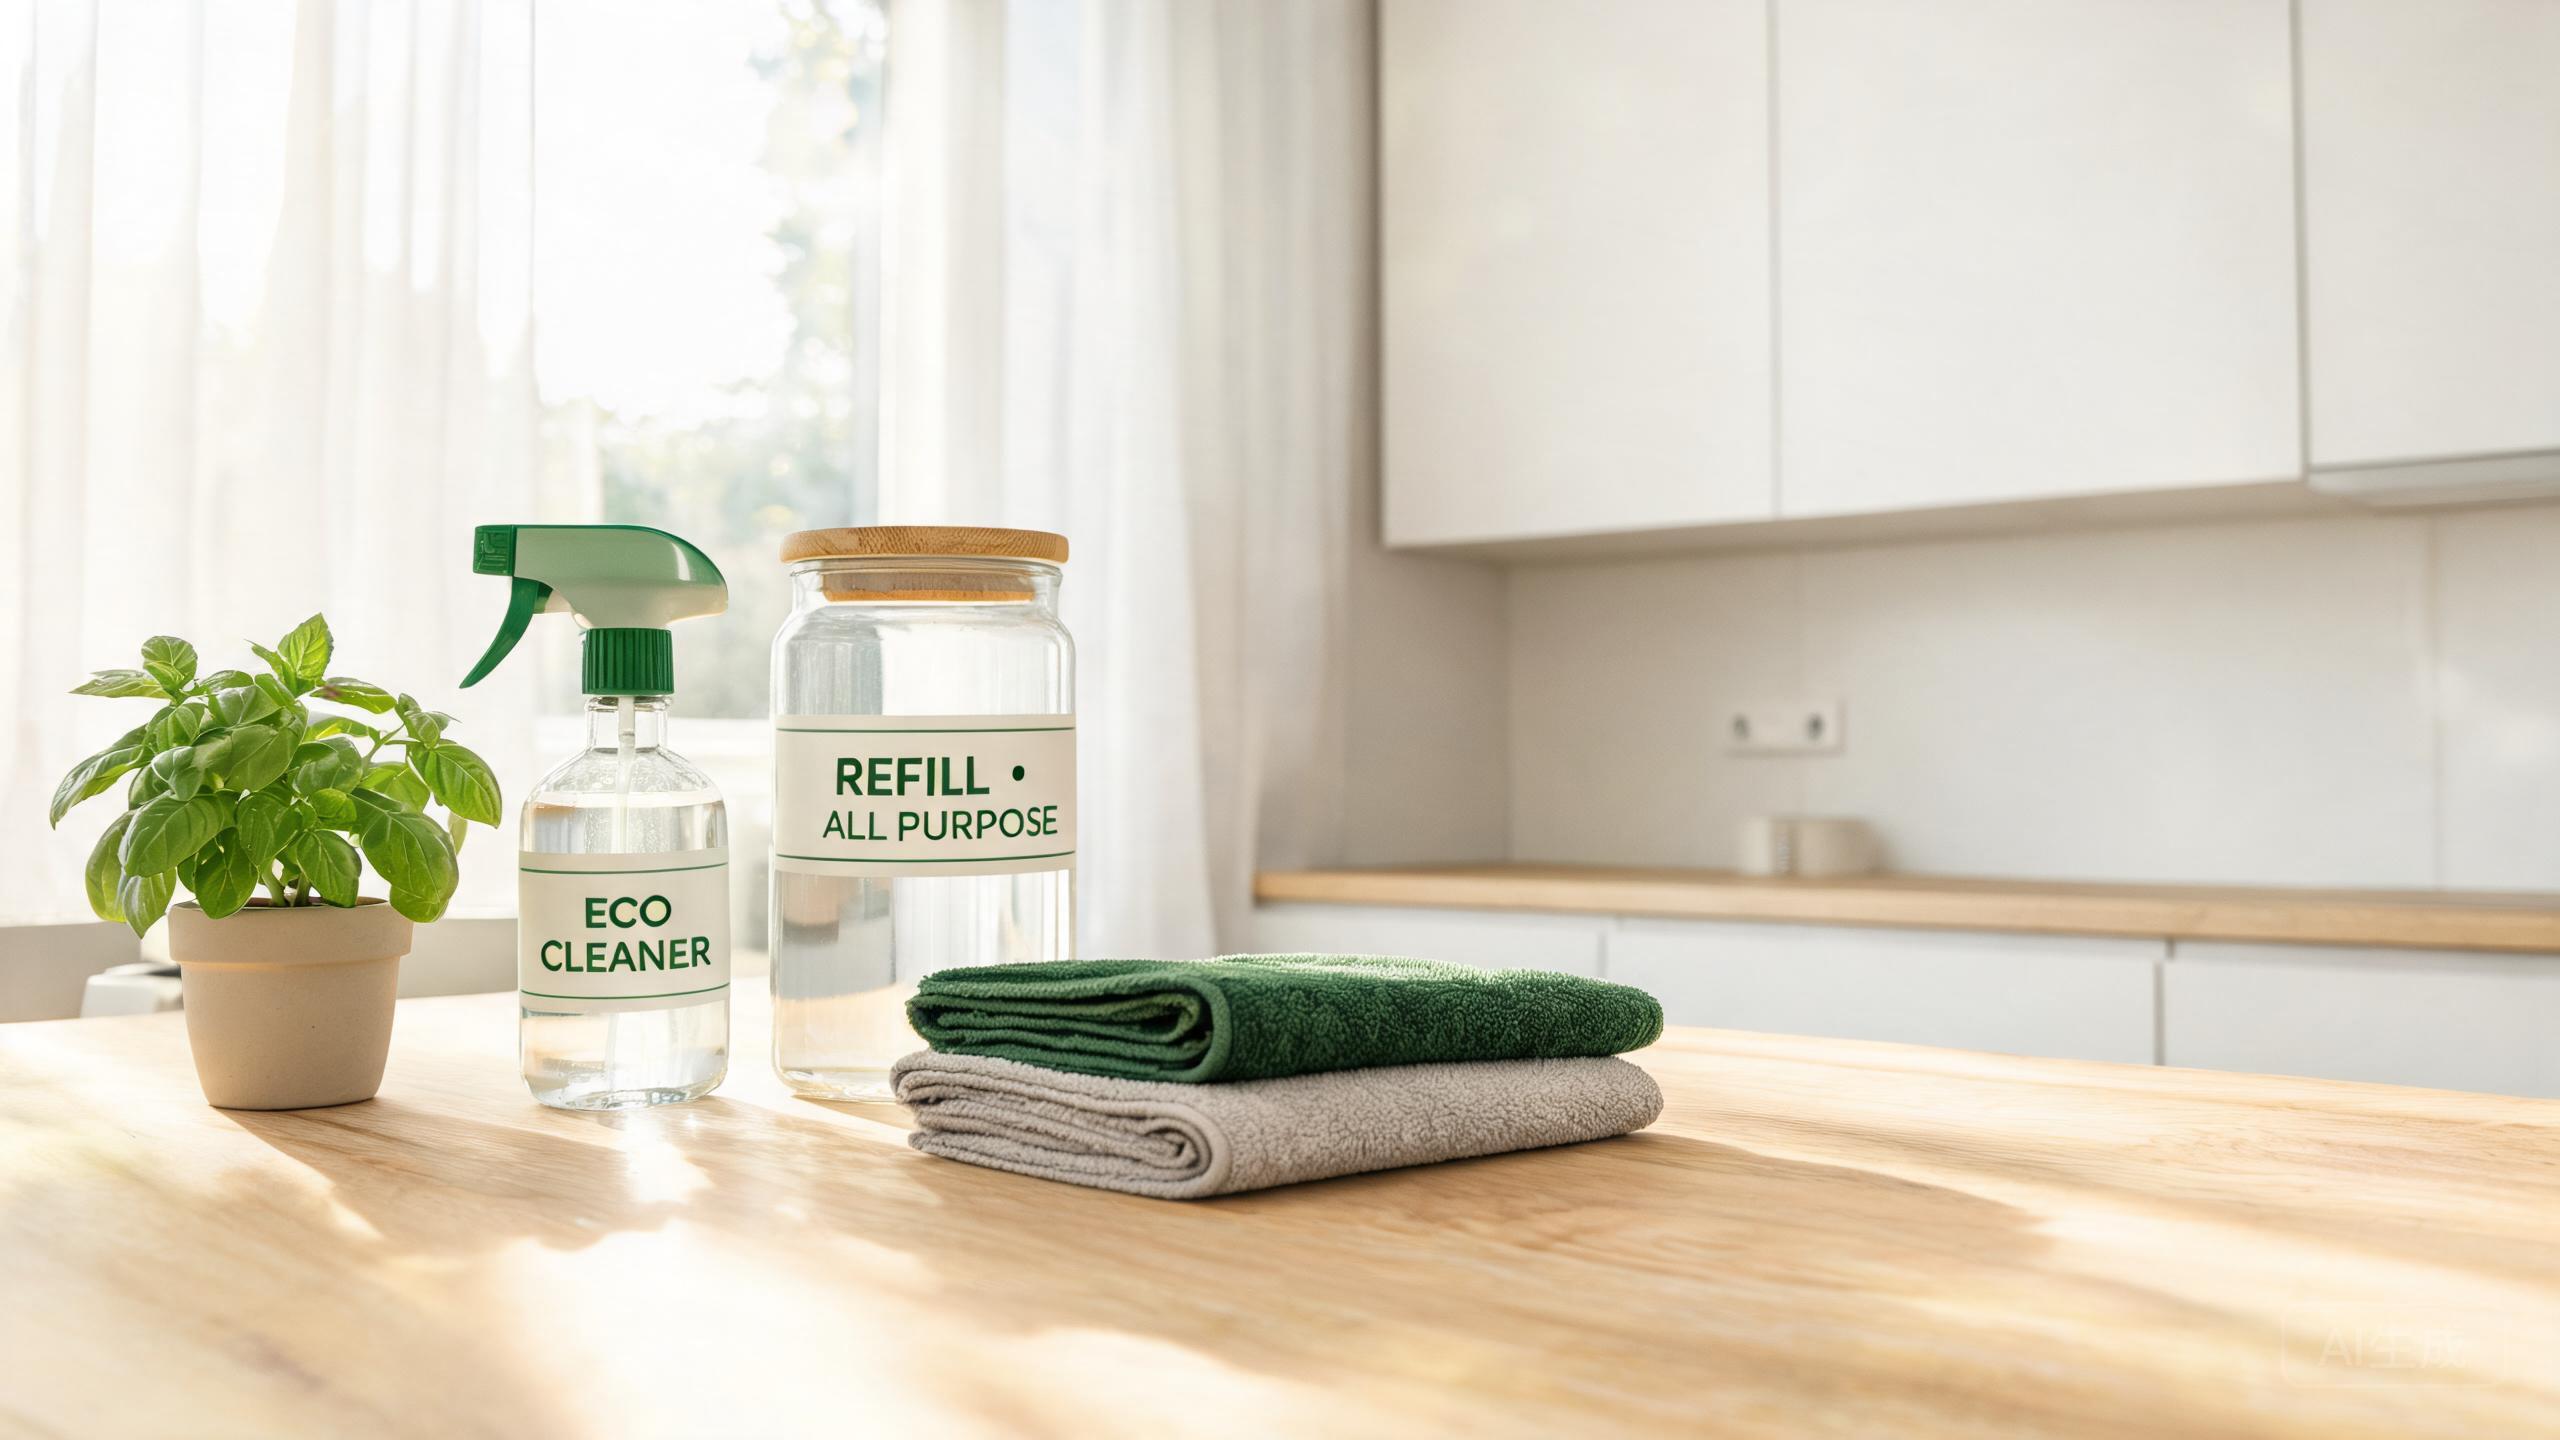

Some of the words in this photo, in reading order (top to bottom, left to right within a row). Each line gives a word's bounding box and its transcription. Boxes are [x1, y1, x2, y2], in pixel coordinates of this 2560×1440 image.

[835, 755, 990, 797] REFILL
[822, 810, 888, 841] ALL
[898, 804, 1058, 842] PURPOSE
[584, 895, 672, 929] ECO
[540, 935, 712, 974] CLEANER
